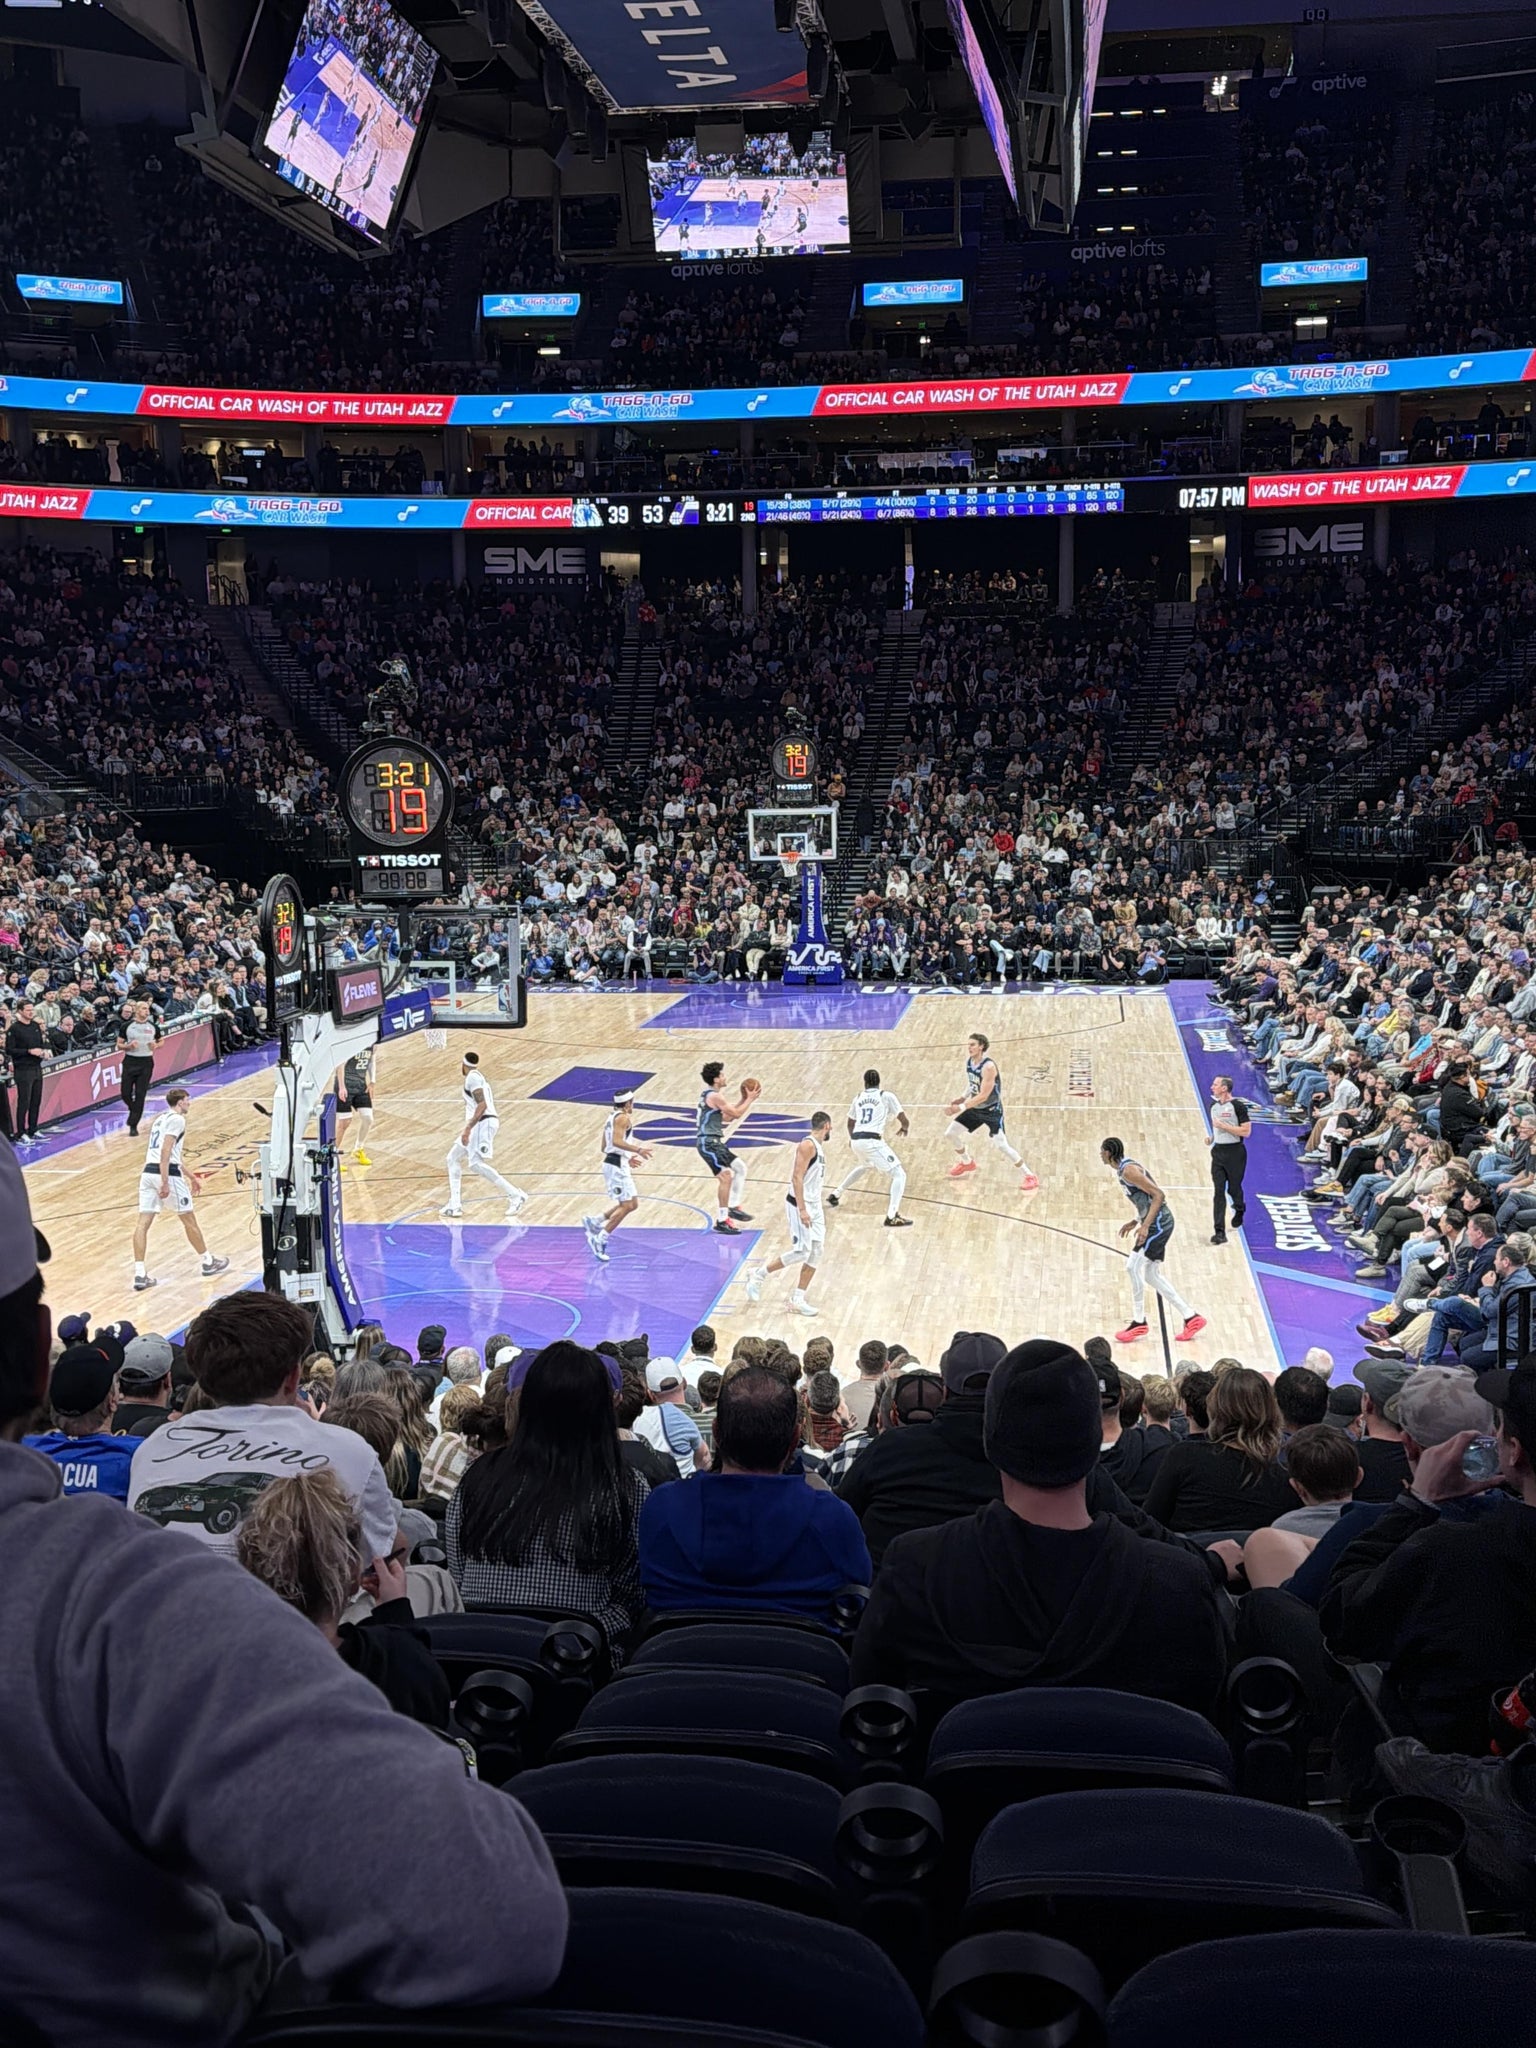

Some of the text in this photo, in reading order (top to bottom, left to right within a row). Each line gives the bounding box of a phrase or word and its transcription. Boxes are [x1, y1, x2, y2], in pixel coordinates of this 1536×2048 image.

[1312, 73, 1368, 95] aptive
[1071, 238, 1166, 263] aptive lofts
[671, 263, 725, 280] aptive
[1303, 377, 1373, 392] CAR WASH
[825, 382, 1118, 408] OFFICIAL CAR WASH OF THE UTAH JAZZ
[149, 393, 443, 417] OFFICIAL CAR WASH OF THE UTAH JAZZ
[616, 405, 679, 418] CAR WASH
[1253, 475, 1452, 499] WASH OF THE UTAH JAZZ
[40, 495, 78, 511] JAZZ
[744, 501, 754, 511] 19
[875, 498, 890, 506] 4/4
[891, 497, 917, 507] (100%)
[948, 496, 957, 505] 15
[966, 495, 978, 504] 20
[988, 495, 995, 504] 11
[1007, 494, 1015, 502] 0
[1027, 493, 1034, 502] 0
[1046, 493, 1056, 501] 10
[1086, 491, 1097, 500] 85
[1104, 490, 1119, 499] 120
[1179, 486, 1245, 509] 07:57 PM
[262, 511, 328, 523] CAR WASH
[475, 504, 573, 521] OFFICIAL CAR
[608, 505, 629, 524] 39
[642, 505, 663, 524] 53
[706, 502, 734, 522] 3:21
[740, 512, 756, 522] 2ND
[877, 509, 892, 518] 6/7
[948, 507, 957, 516] 18
[966, 506, 978, 516] 26
[987, 506, 996, 515] 15
[1047, 504, 1054, 513] 3
[1067, 503, 1076, 512] 18
[1085, 503, 1099, 511] 120
[1106, 502, 1118, 511] 85
[1254, 523, 1364, 556] SME
[484, 547, 587, 575] SME
[1257, 555, 1360, 568] INDUSRIES
[495, 577, 584, 586] NDUSTRIES
[785, 744, 809, 757] 3:21
[377, 762, 430, 788] 3:21
[788, 756, 807, 777] 19
[786, 783, 813, 791] TISSOT
[388, 788, 428, 834] 19
[380, 853, 442, 867] TISSOT
[279, 926, 292, 955] 19
[860, 985, 1166, 996] UTAH JAZZ
[355, 1060, 369, 1070] 22
[860, 1108, 874, 1125] 13
[1255, 1193, 1333, 1252] SEATGEEK
[333, 1208, 358, 1305] AMERICA
[151, 1426, 331, 1471] Torino
